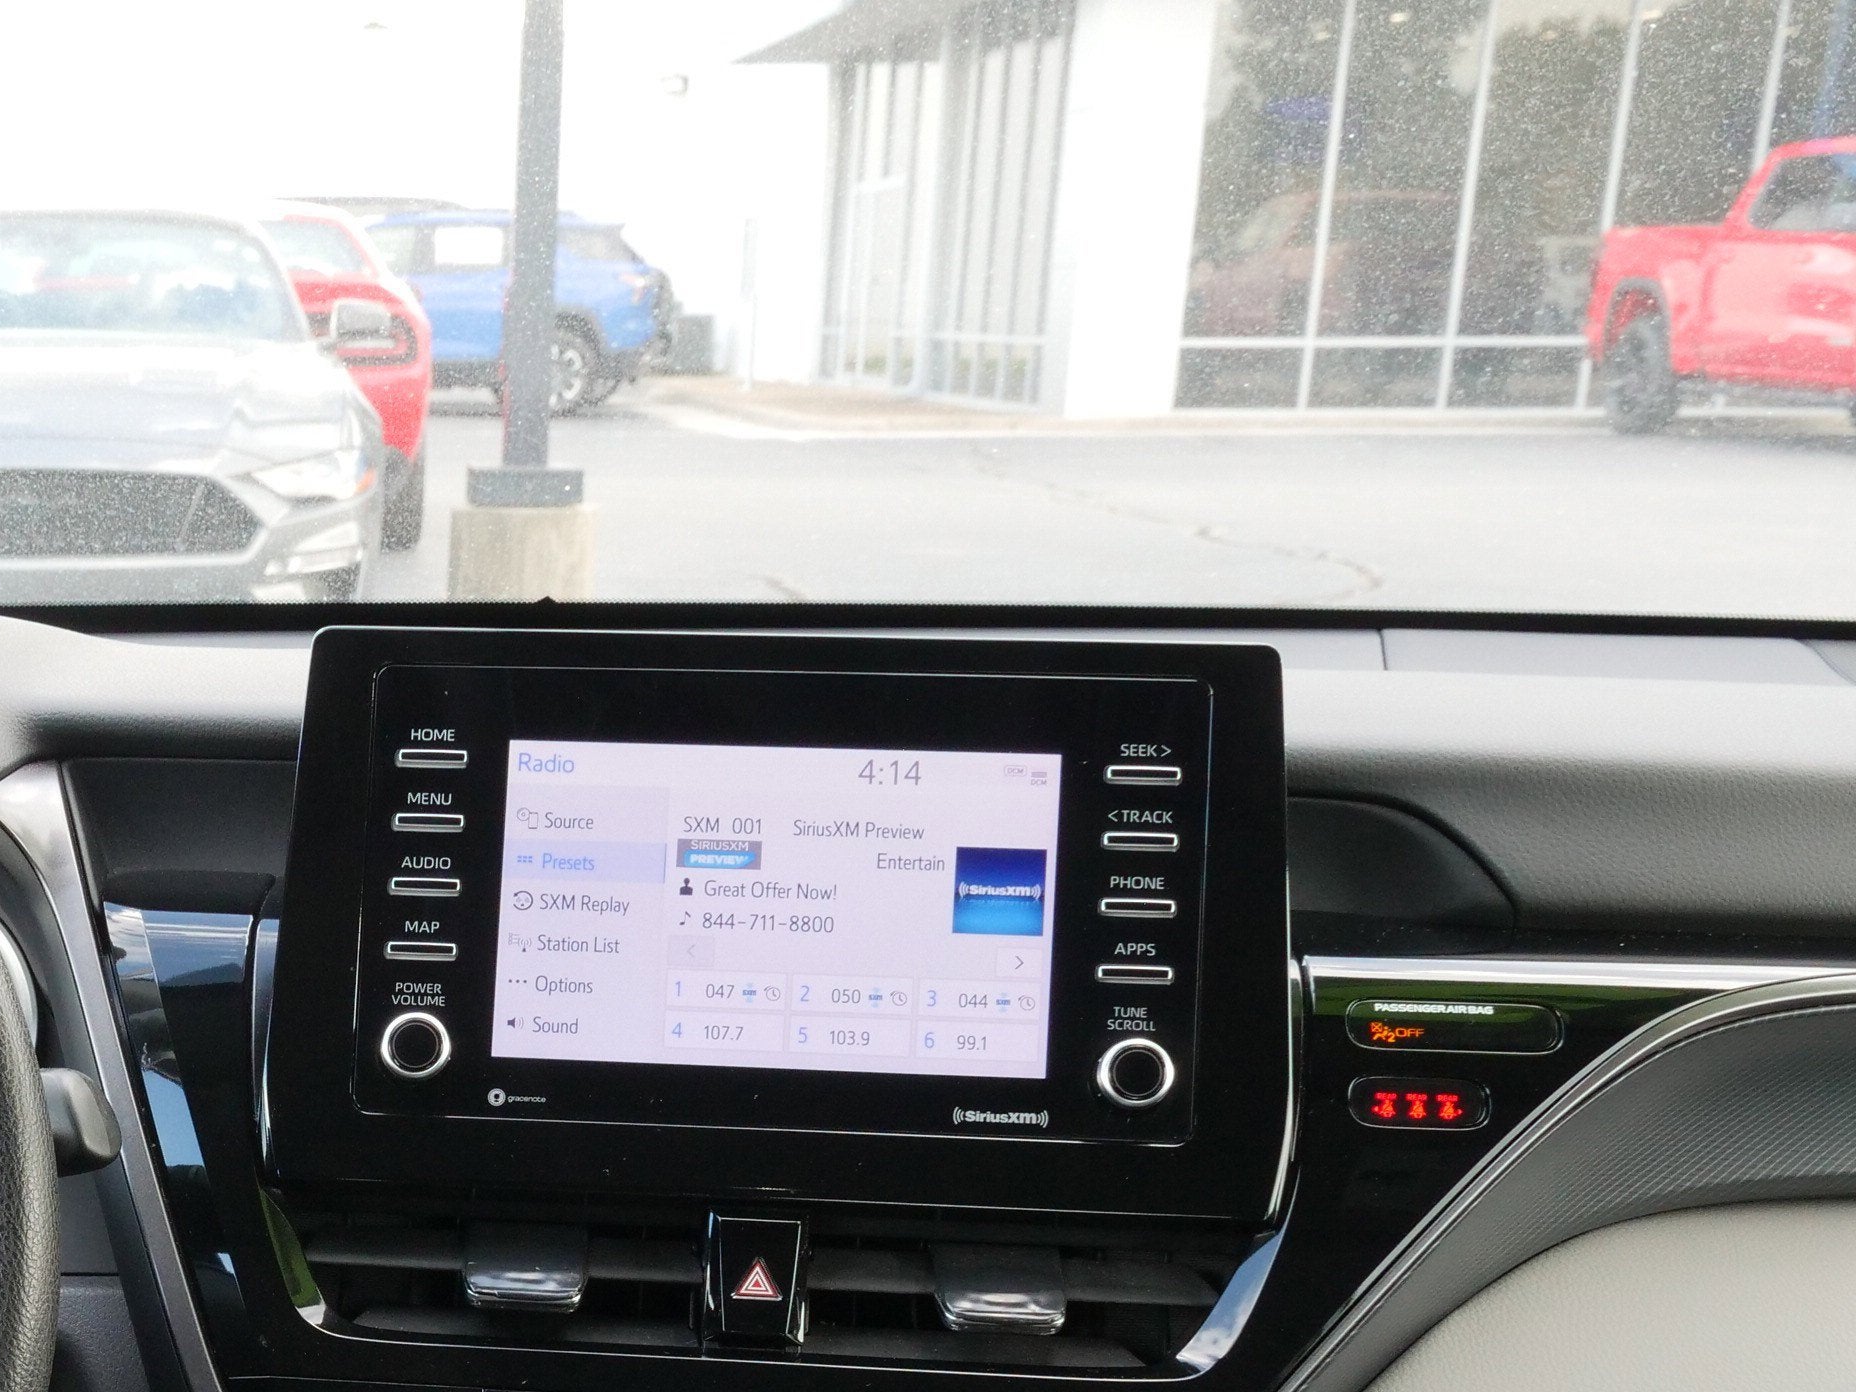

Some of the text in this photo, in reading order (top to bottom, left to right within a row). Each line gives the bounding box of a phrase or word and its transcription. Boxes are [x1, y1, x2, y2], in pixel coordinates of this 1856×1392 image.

[410, 728, 456, 742] HOME
[1120, 743, 1158, 757] SEEK
[518, 753, 575, 773] Radio
[858, 759, 922, 786] 4:14
[407, 792, 452, 805] MENU
[545, 812, 594, 830] Source
[1121, 810, 1173, 824] TRACK
[683, 816, 762, 835] SXM 001
[794, 820, 925, 840] SiriusXM Preview
[691, 839, 749, 851] SIRIUSXM
[401, 856, 451, 870] AUDIO
[542, 853, 595, 871] Presets
[689, 853, 749, 866] PREVIEW
[877, 853, 945, 871] Entertain
[704, 880, 837, 900] Great Offer Now!
[967, 884, 1033, 897] SiriusXM
[1110, 876, 1165, 890] PHONE
[539, 893, 630, 916] SXM Replay
[404, 920, 440, 933] MAP
[702, 912, 834, 933] 844-711-8800
[538, 934, 620, 954] Station List
[1114, 943, 1156, 956] APPS
[395, 982, 442, 995] POWER
[535, 975, 593, 995] Options
[675, 981, 682, 997] 1
[705, 984, 735, 999] 047
[391, 994, 446, 1007] VOLUME
[800, 985, 810, 1002] 2
[831, 988, 861, 1004] 050
[927, 990, 937, 1007] 3
[958, 993, 988, 1009] 044
[1113, 1007, 1148, 1018] TUNE
[1374, 1003, 1446, 1013] PASSENGER
[532, 1016, 578, 1035] Sound
[672, 1022, 744, 1041] 4 107.7
[1107, 1019, 1156, 1032] SCROLL
[1395, 1028, 1425, 1038] OFF
[798, 1027, 871, 1046] 5 103.9
[924, 1032, 987, 1051] 6 99.1
[1375, 1092, 1397, 1100] REAR
[1406, 1093, 1427, 1101] REAR
[965, 1110, 1038, 1125] SiriusXM
